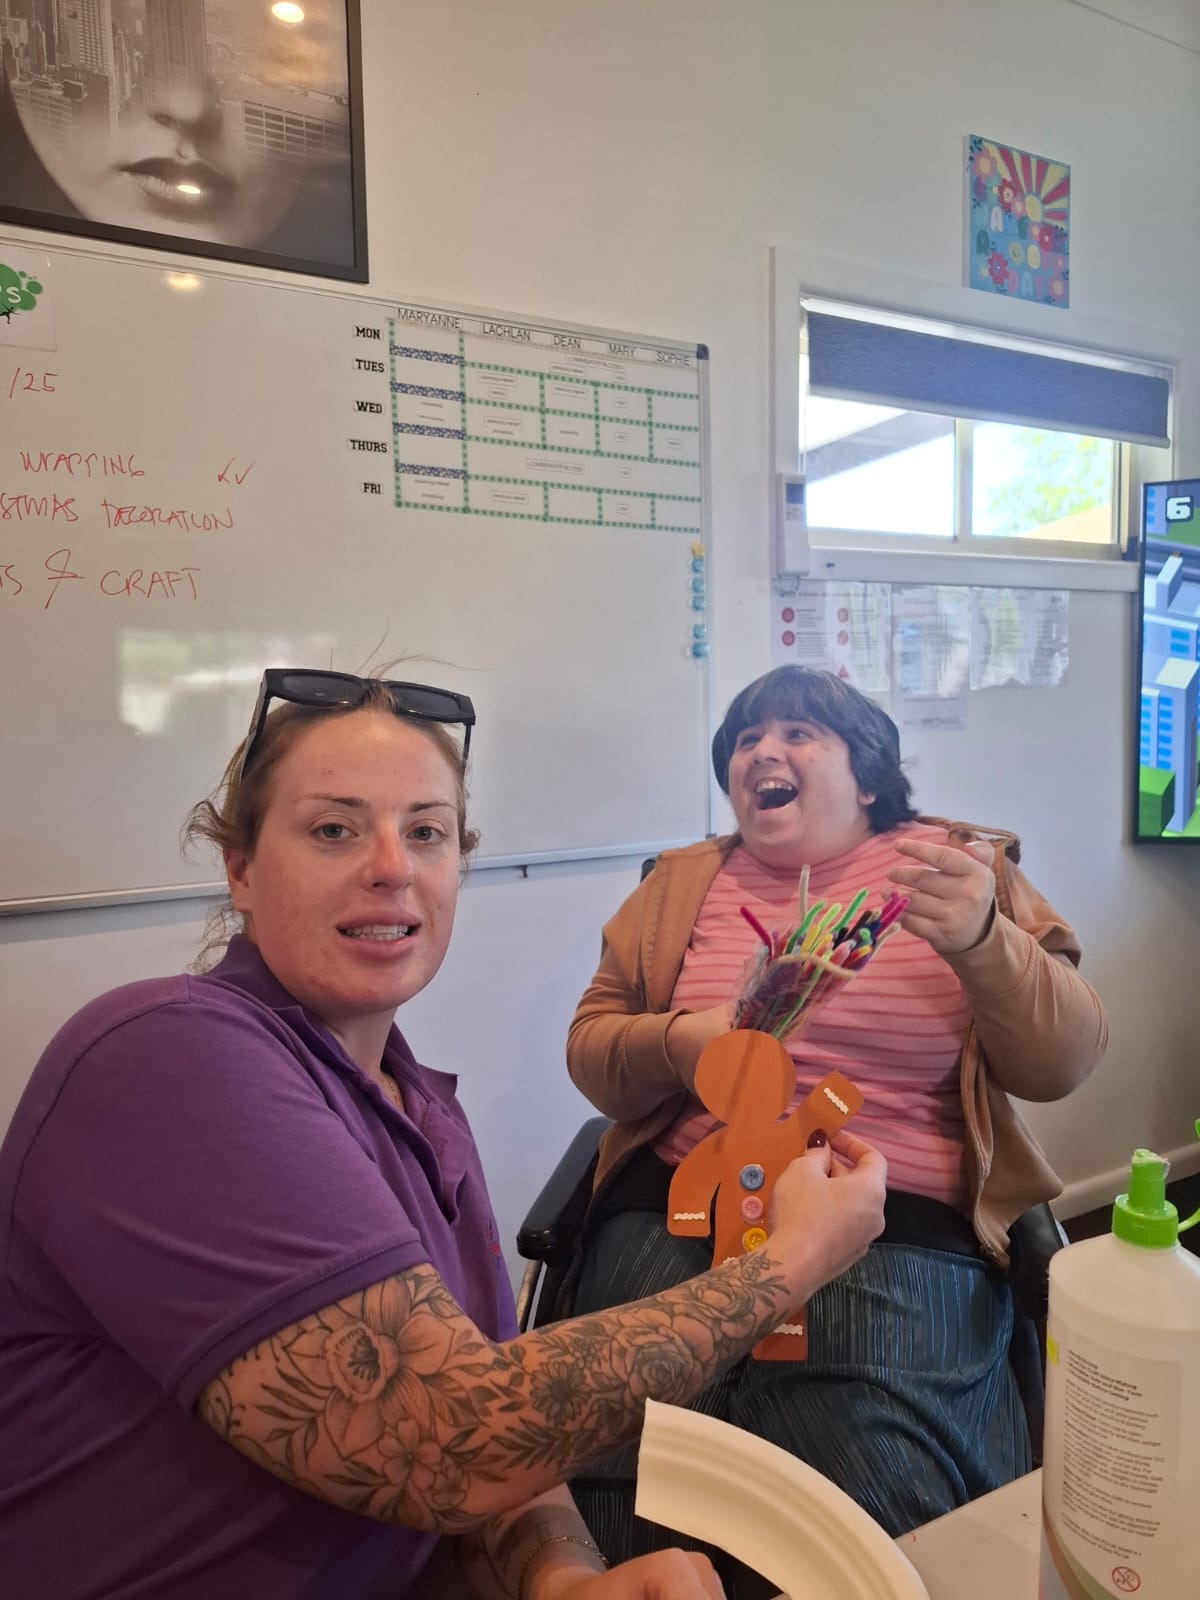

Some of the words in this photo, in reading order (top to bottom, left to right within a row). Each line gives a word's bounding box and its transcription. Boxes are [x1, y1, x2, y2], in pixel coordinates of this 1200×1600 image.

[355, 326, 381, 340] MON
[397, 308, 460, 329] MARYANNE
[482, 323, 531, 342] LACHLAN
[553, 335, 581, 349] DEAN
[608, 343, 636, 357] MARY
[655, 351, 690, 367] SOPHIE
[355, 358, 385, 373] TUES
[356, 400, 383, 414] WED
[350, 439, 388, 453] THURS
[363, 482, 381, 495] FRI
[1166, 496, 1191, 520] 6
[100, 568, 200, 601] CRAFT
